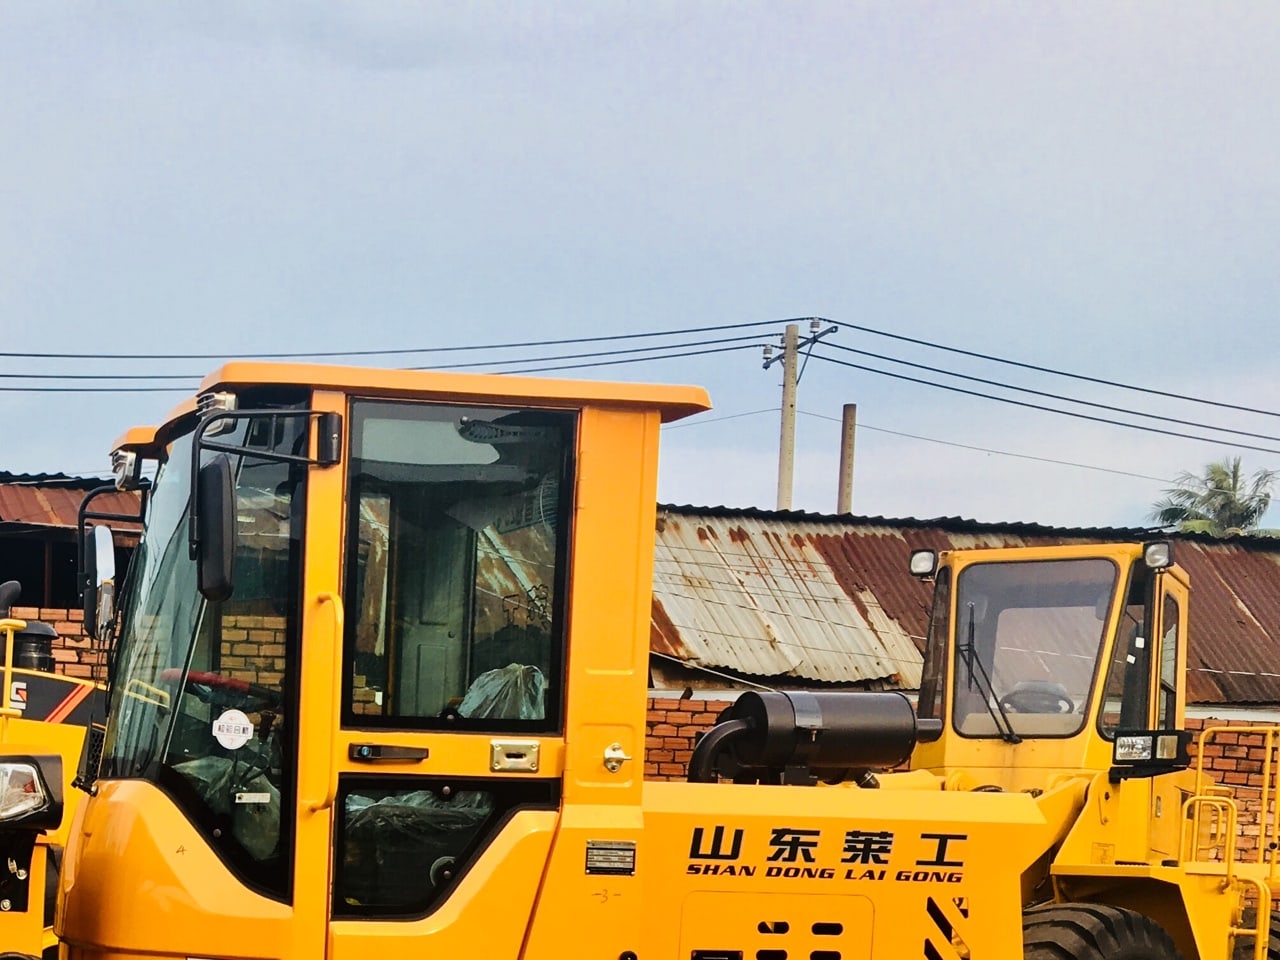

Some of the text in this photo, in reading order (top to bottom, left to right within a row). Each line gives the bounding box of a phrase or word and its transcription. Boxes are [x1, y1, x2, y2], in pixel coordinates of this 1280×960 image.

[689, 825, 969, 867] 山东莱工
[686, 864, 963, 883] SHAN DONG LAI GONG
